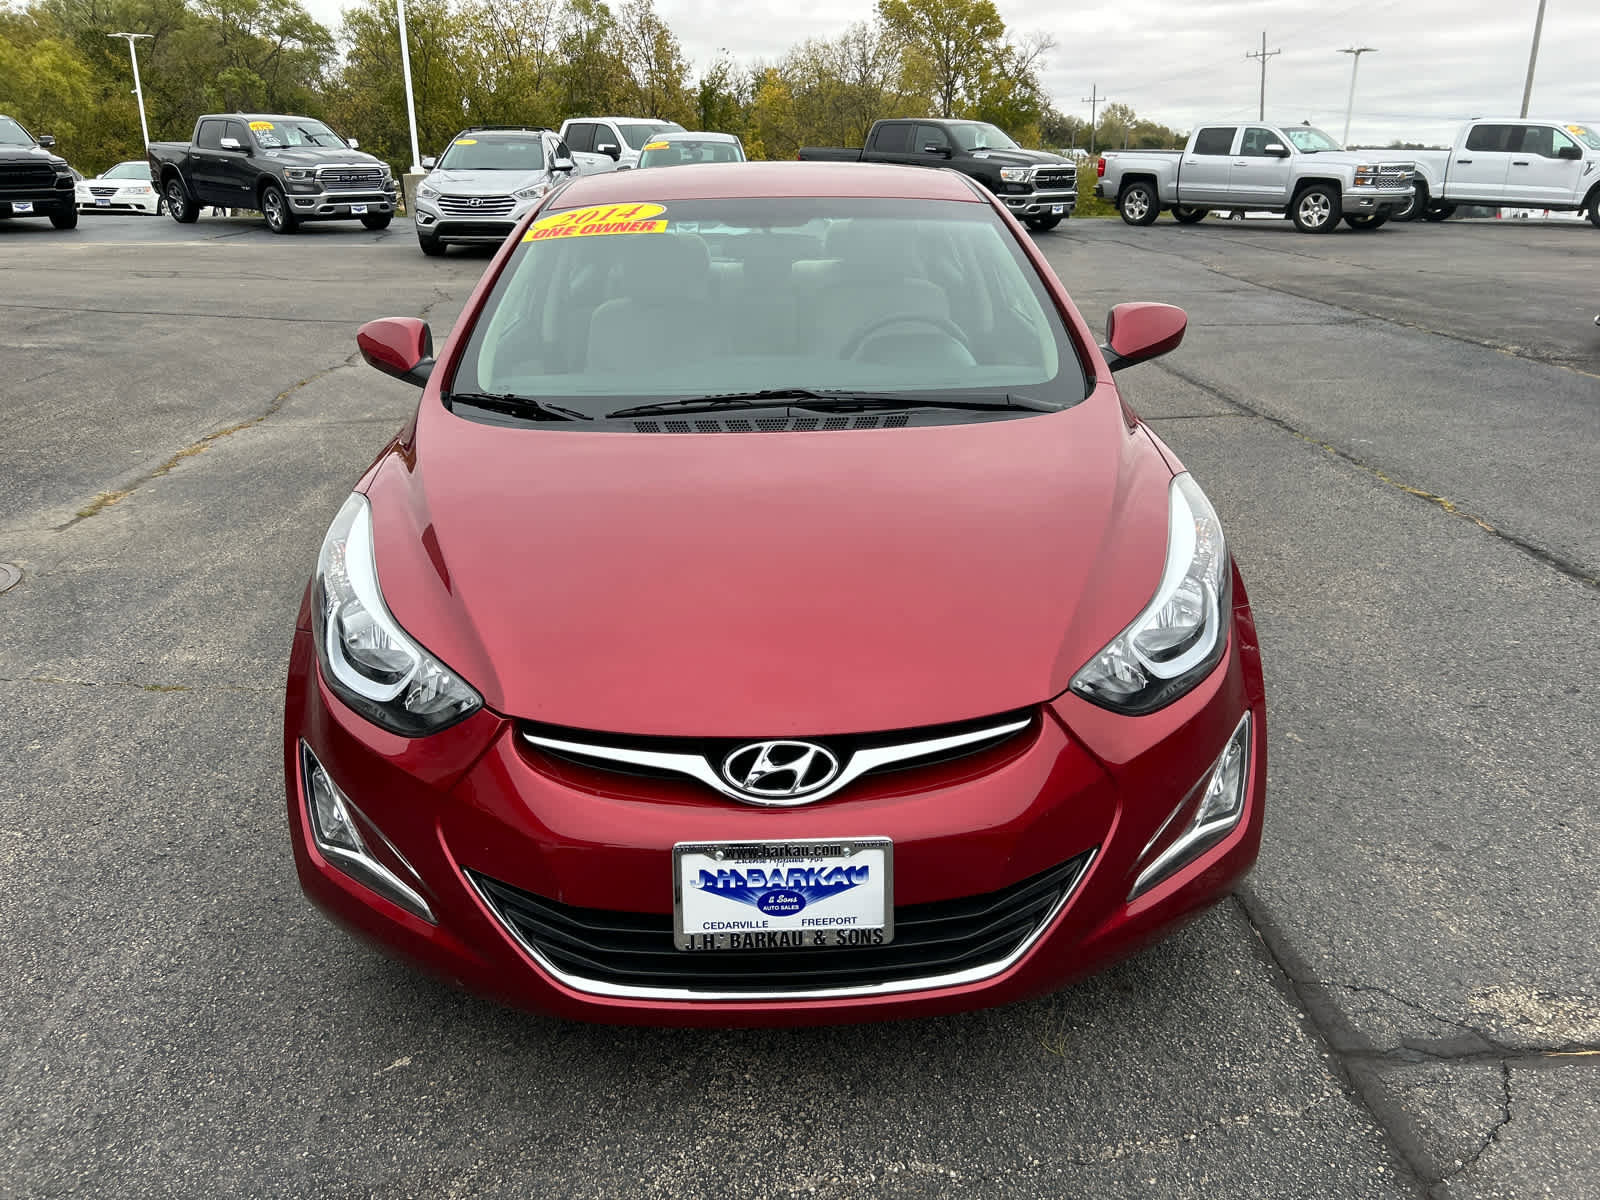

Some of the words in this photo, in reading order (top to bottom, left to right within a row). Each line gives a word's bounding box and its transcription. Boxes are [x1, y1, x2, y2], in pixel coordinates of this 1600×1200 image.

[556, 204, 644, 227] 2014
[532, 225, 579, 239] ONE
[579, 221, 658, 234] OWNER
[724, 843, 841, 859] www.barkau.com
[777, 894, 798, 903] Sons
[703, 920, 769, 930] CEDARVILLE
[801, 916, 857, 926] FREEPORT
[685, 934, 721, 950] J.H.
[730, 931, 803, 949] BARKAU
[814, 929, 826, 946] &
[836, 928, 884, 945] SONS
